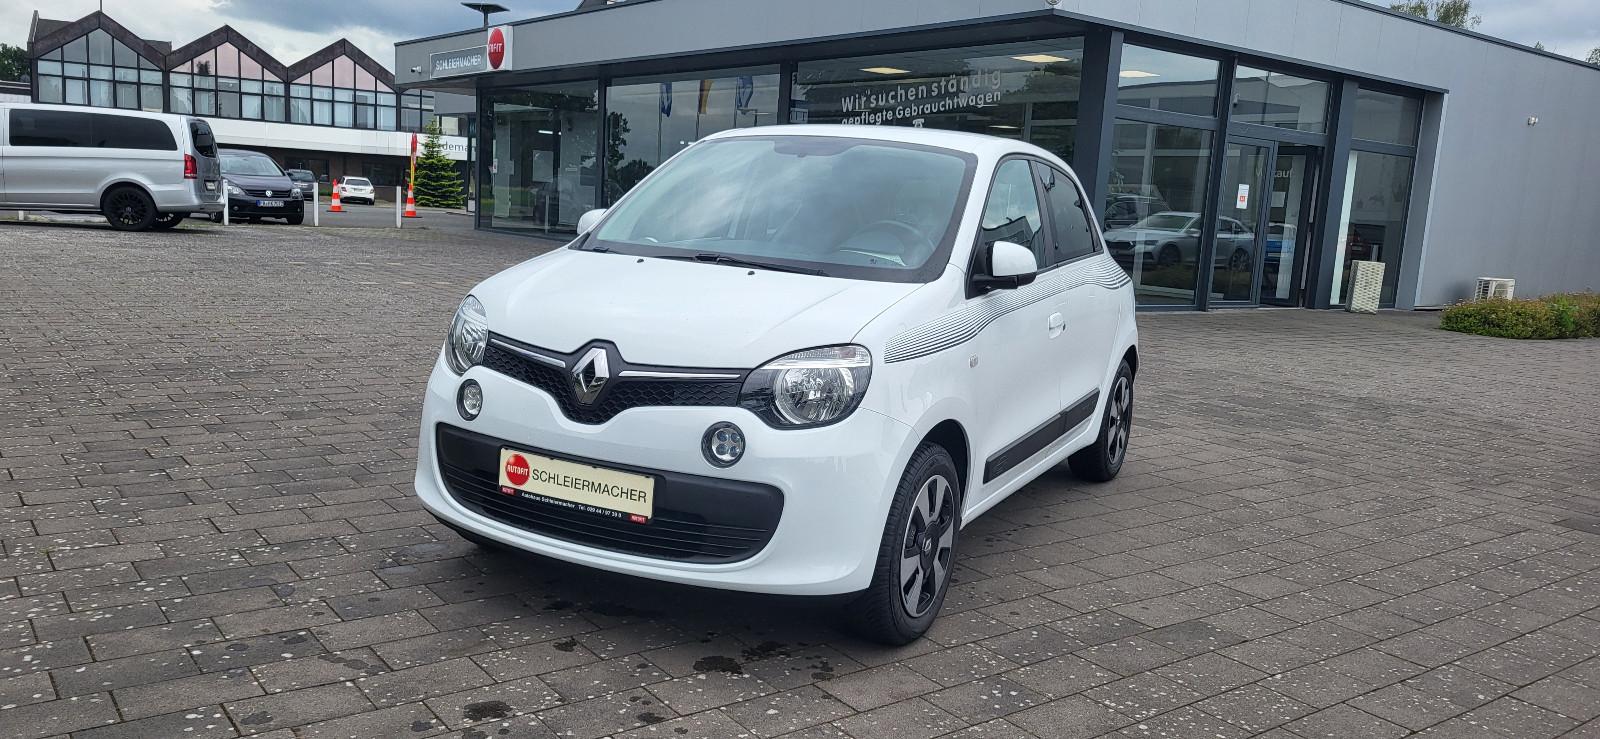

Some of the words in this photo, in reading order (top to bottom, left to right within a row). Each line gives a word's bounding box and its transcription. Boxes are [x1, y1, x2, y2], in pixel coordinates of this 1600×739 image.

[435, 54, 482, 71] SCHLEIERMACHER
[841, 95, 866, 112] Wir
[870, 86, 927, 107] suchen
[931, 69, 1001, 96] ständig
[895, 91, 1001, 118] Gebrauchtwagen
[507, 464, 529, 476] AUTOFIT
[532, 469, 647, 504] SCHLEIERMACHER
